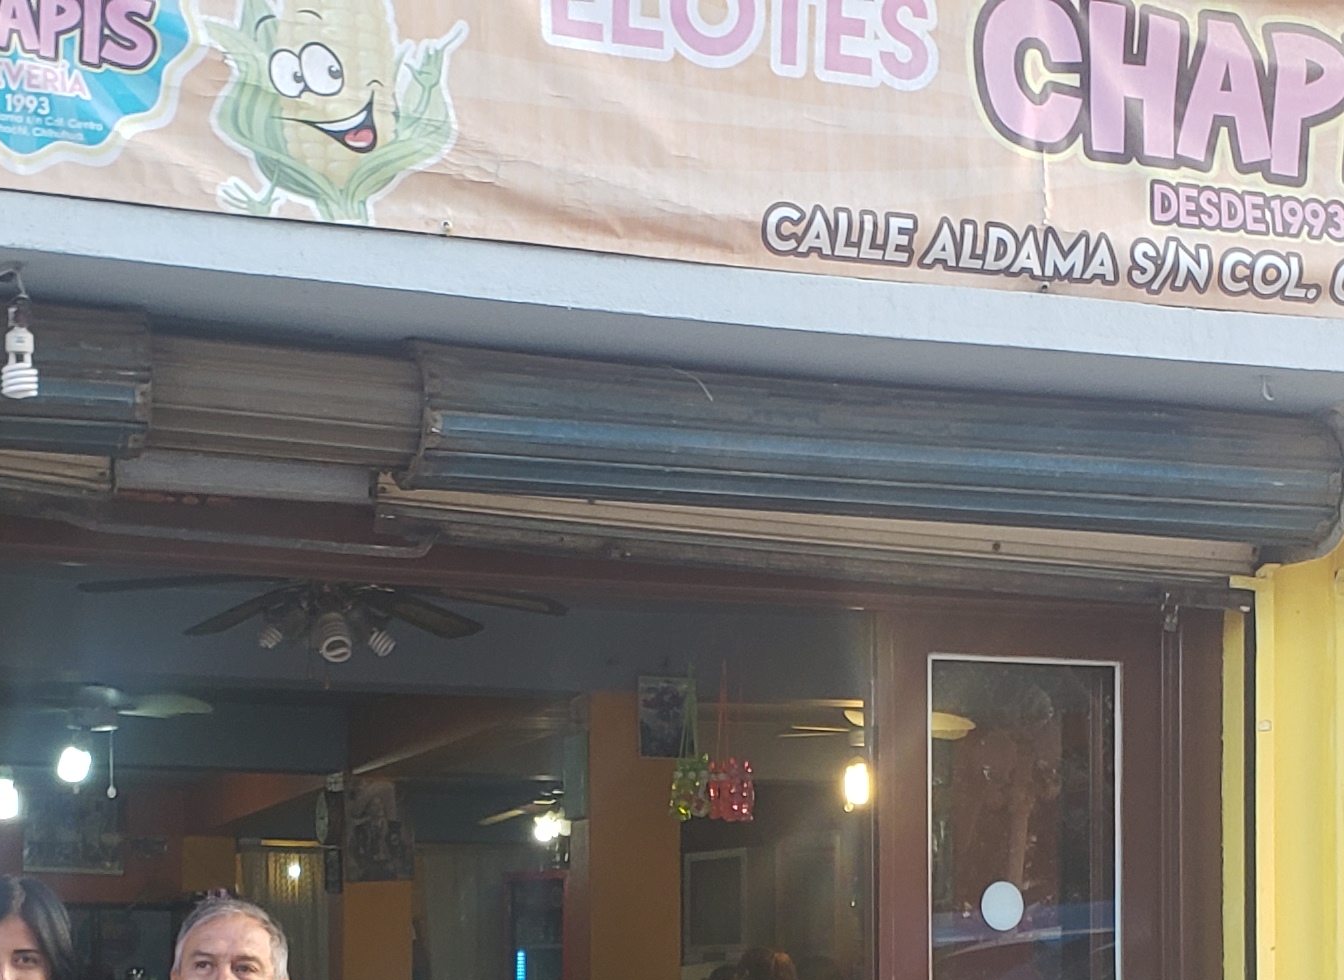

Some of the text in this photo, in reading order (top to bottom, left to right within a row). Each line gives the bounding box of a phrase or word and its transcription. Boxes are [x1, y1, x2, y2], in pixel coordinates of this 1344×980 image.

[5, 93, 51, 115] 1993
[1151, 179, 1269, 235] DESDE
[762, 202, 917, 264] CALLE
[919, 217, 1119, 286] ALDAMA
[1127, 234, 1212, 295] S/N
[1219, 248, 1321, 302] COL.
